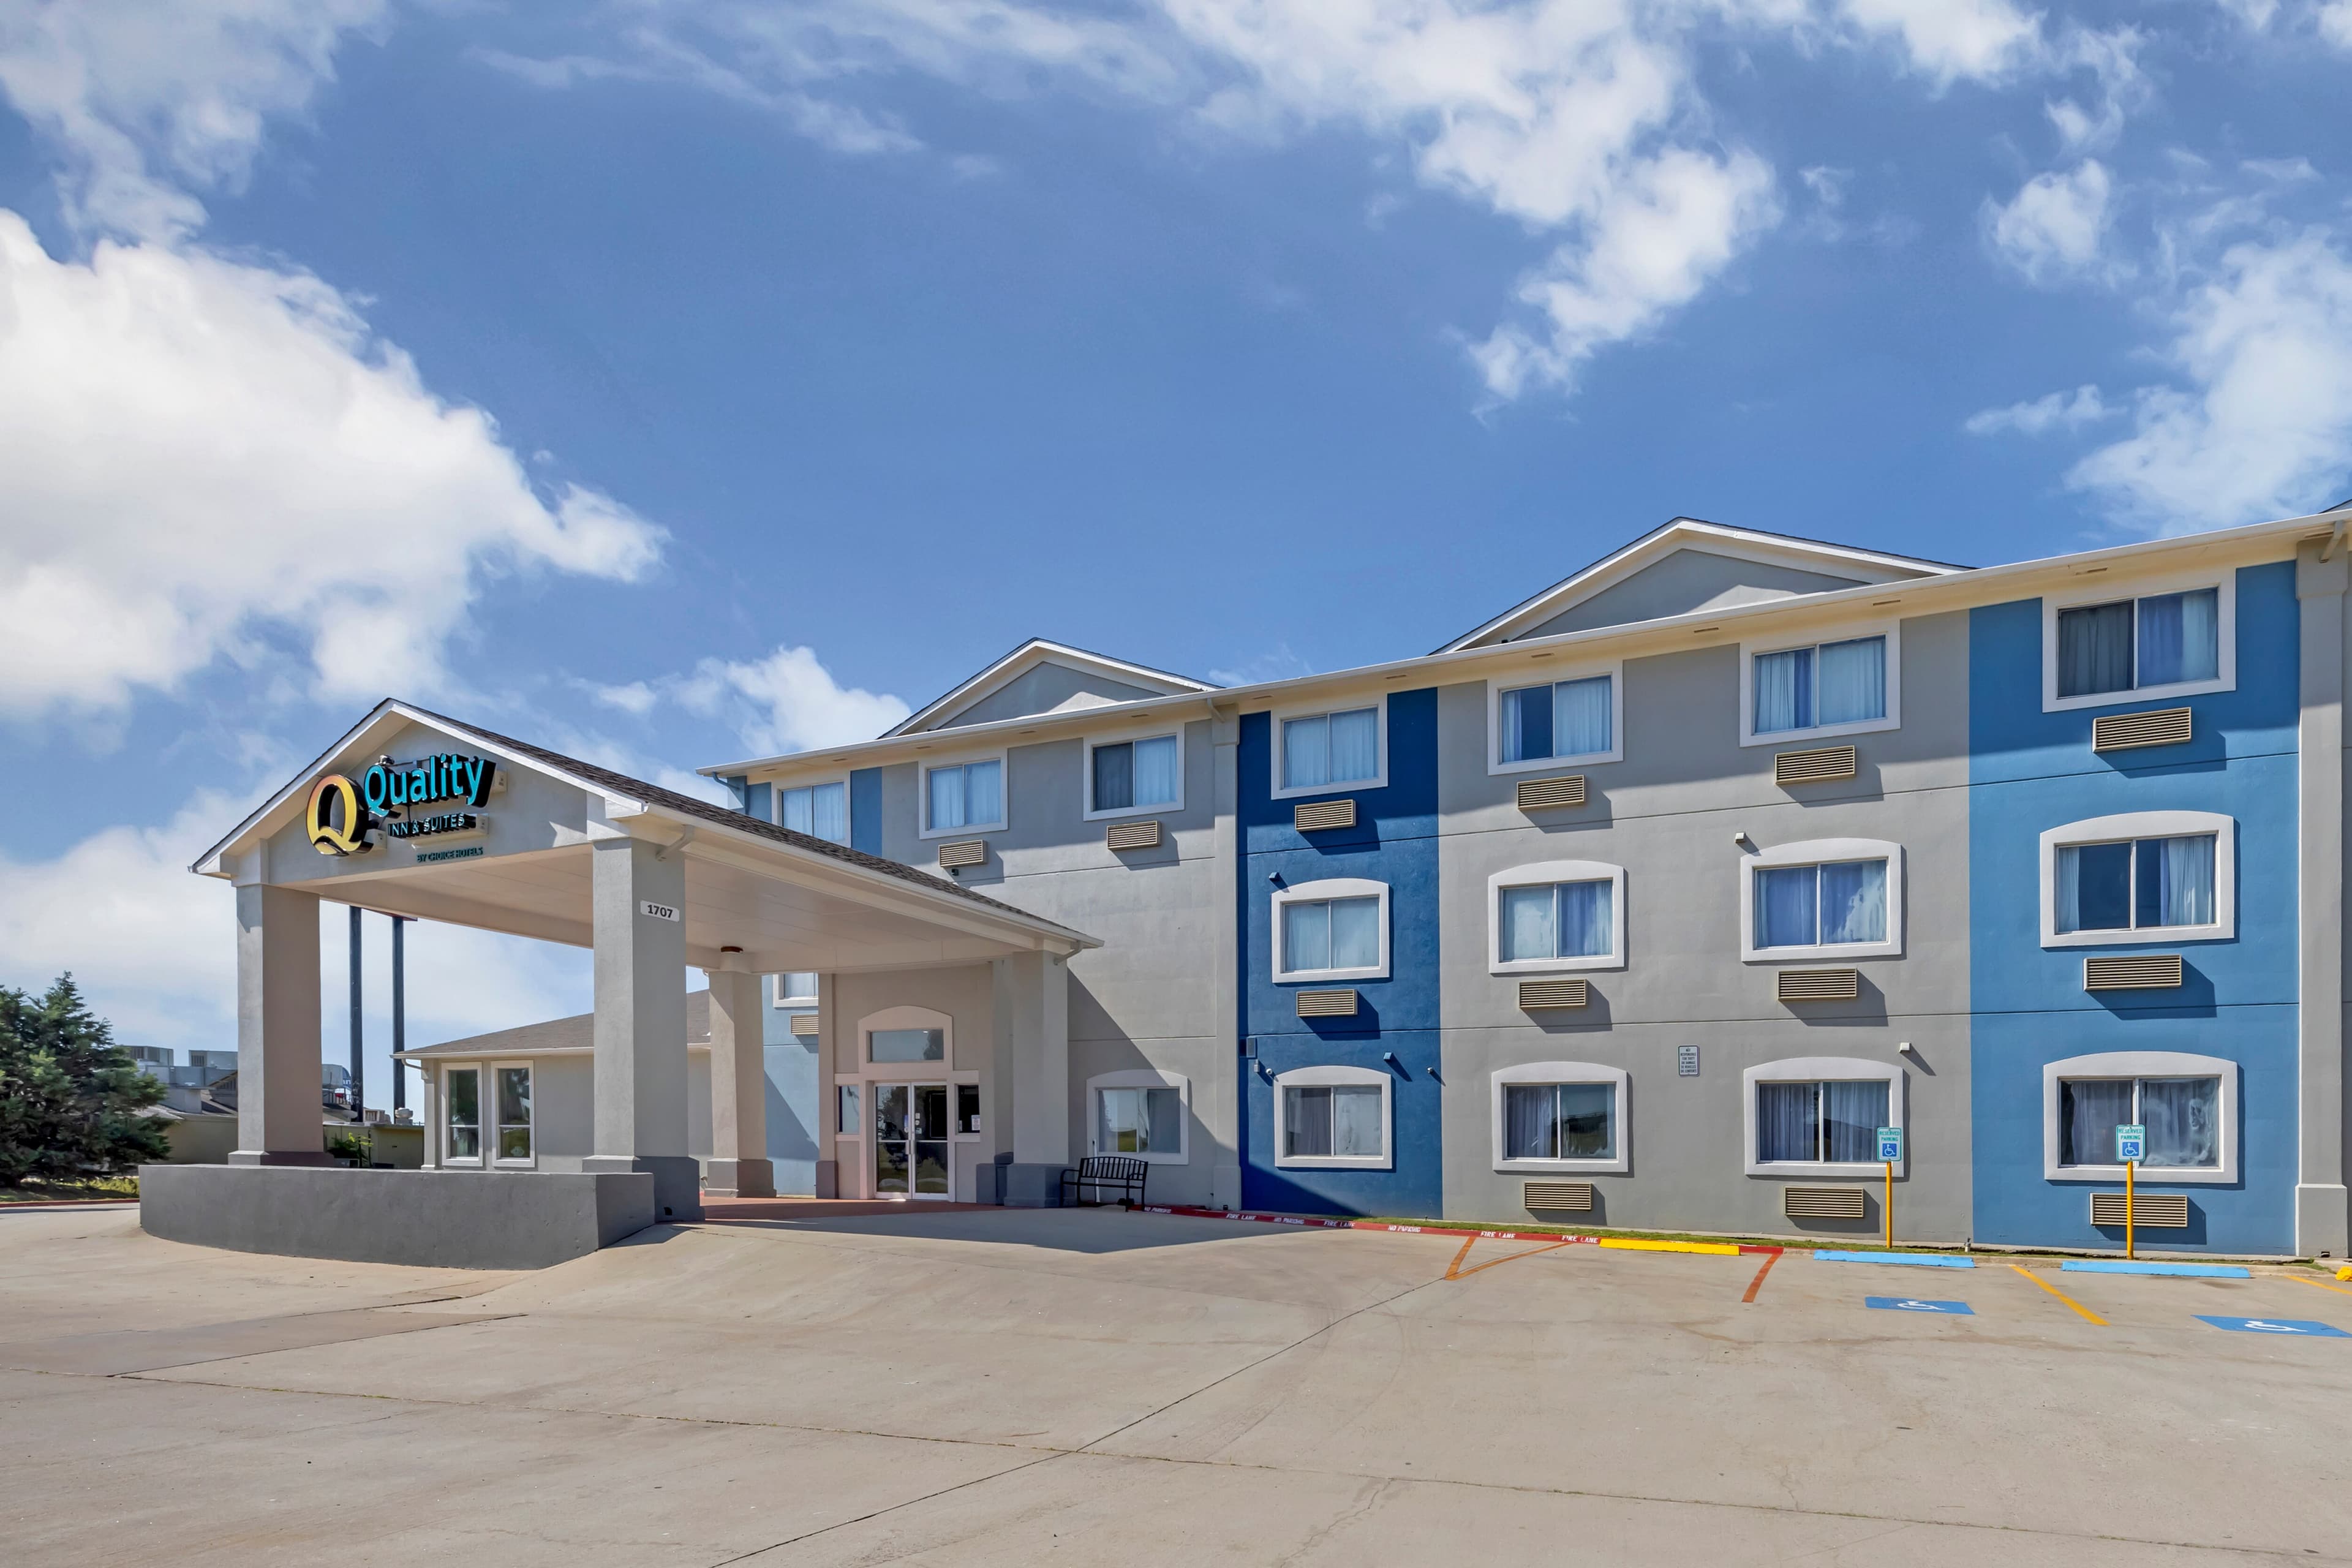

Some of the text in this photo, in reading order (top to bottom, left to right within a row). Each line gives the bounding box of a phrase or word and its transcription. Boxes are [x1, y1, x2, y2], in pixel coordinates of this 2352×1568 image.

[364, 753, 484, 817] Quality
[306, 774, 362, 855] Q
[388, 812, 465, 836] INN & SUITES
[417, 847, 484, 863] BY CHOICE HOTELS
[647, 905, 673, 918] 1707
